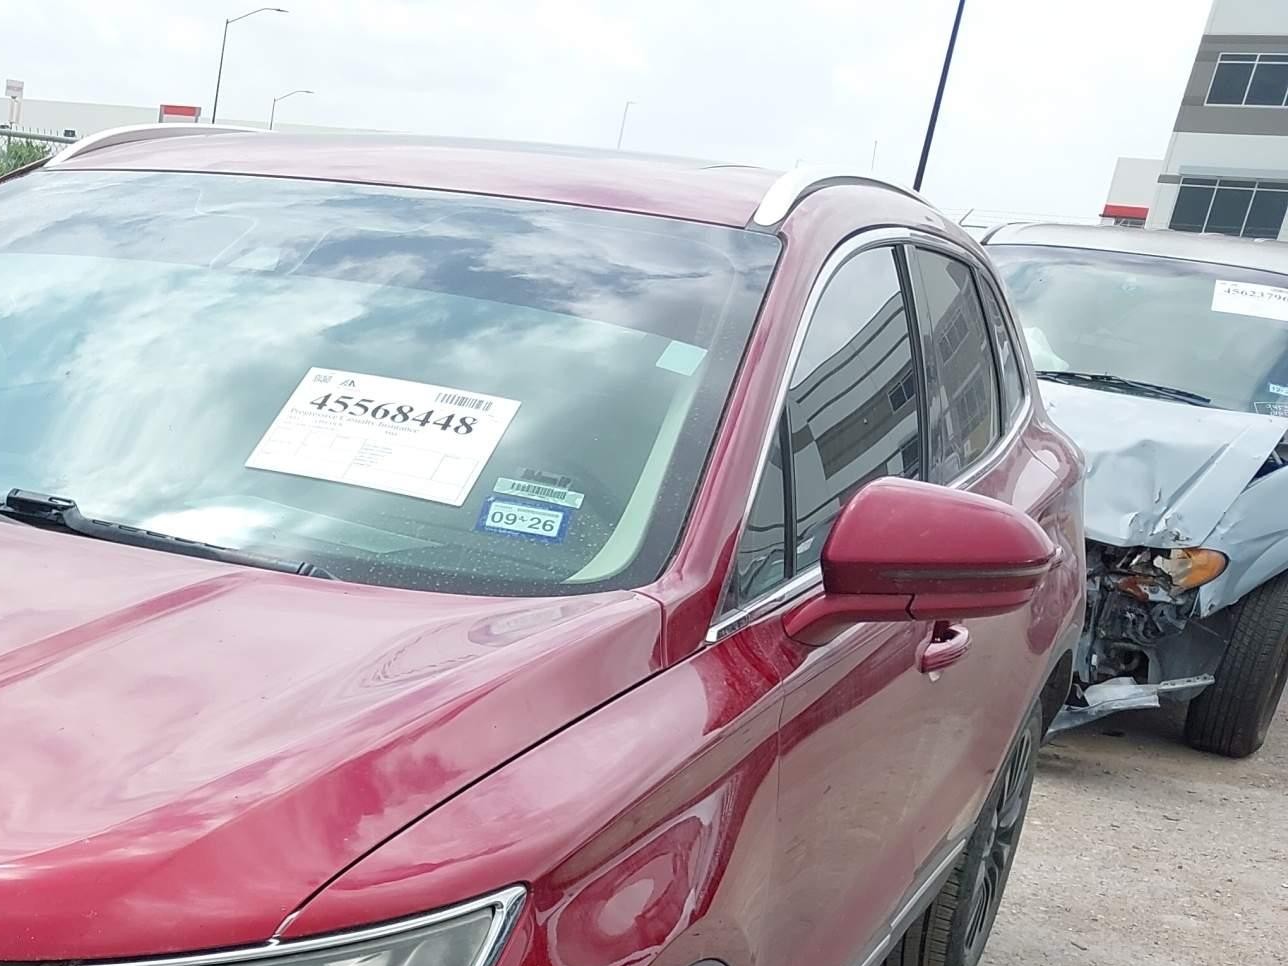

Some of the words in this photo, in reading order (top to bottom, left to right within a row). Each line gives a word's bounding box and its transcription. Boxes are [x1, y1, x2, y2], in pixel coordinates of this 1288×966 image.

[309, 392, 480, 435] 45568448
[491, 511, 518, 526] 09
[527, 516, 555, 532] 26
